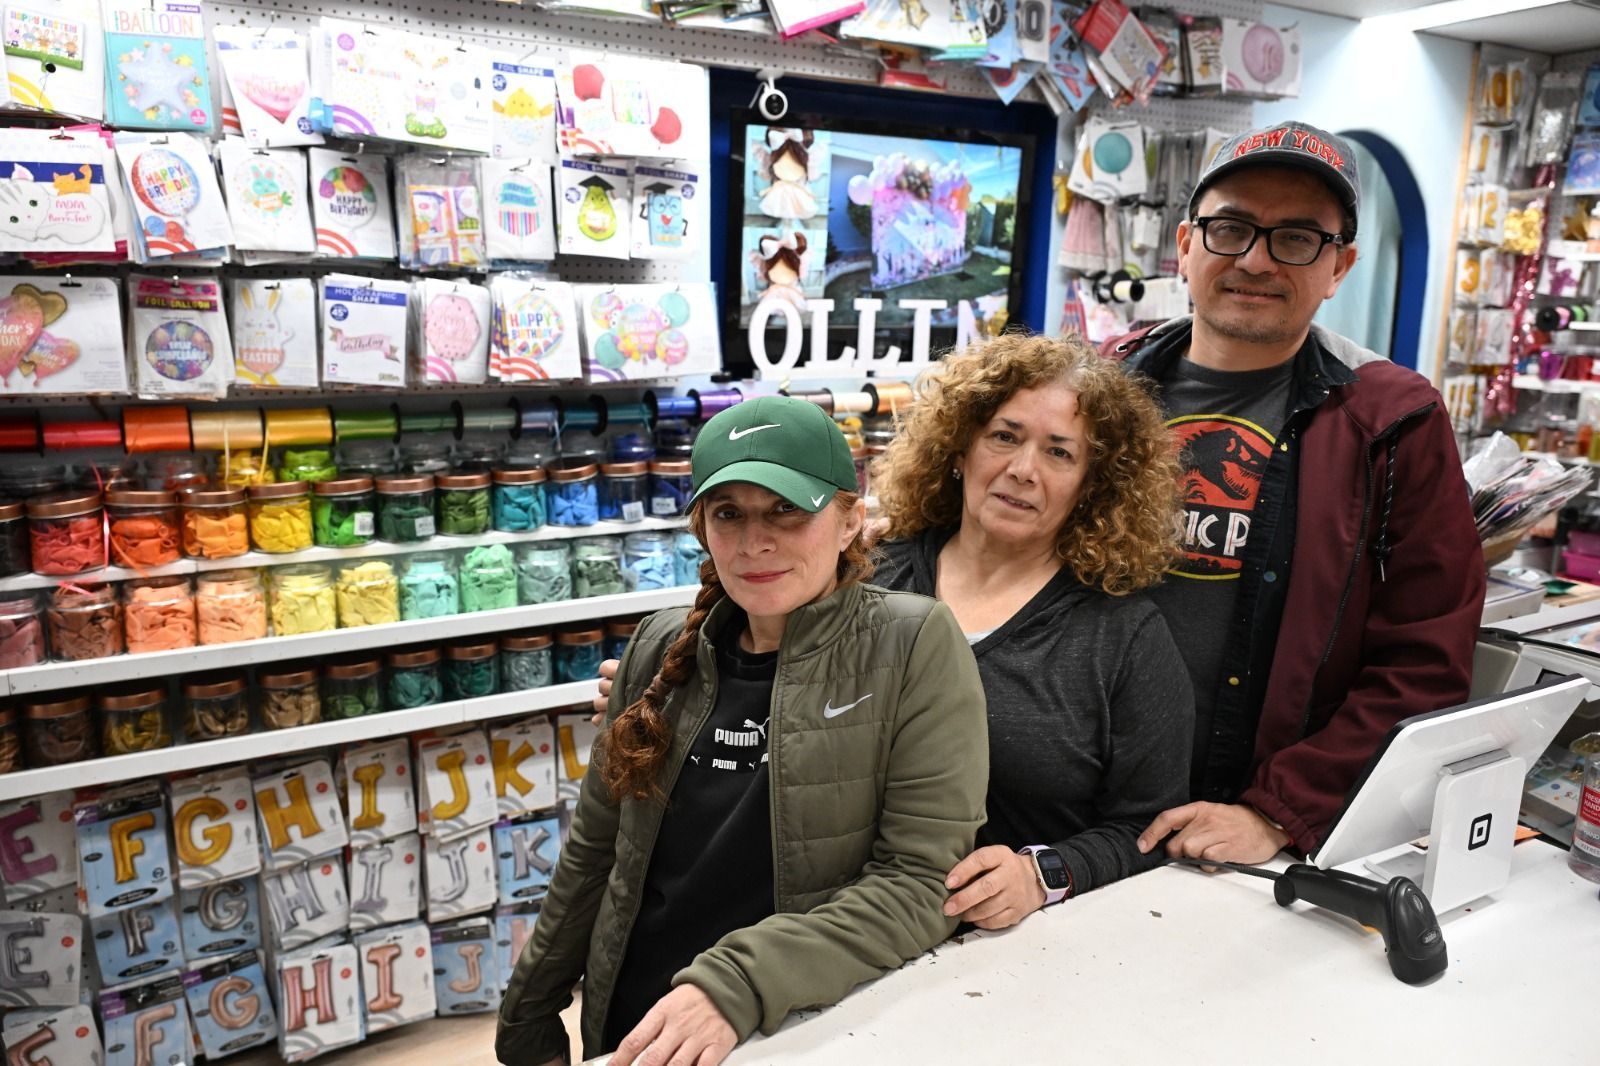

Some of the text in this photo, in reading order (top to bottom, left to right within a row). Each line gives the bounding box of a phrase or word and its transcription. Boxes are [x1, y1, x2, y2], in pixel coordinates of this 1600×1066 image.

[119, 10, 193, 35] BALLOON
[518, 66, 543, 75] SHAPE
[571, 162, 617, 174] FOIL SHAPE
[1234, 127, 1344, 171] NEW YORK
[145, 163, 183, 186] HAPPY
[147, 176, 192, 199] BIRTHDAY
[664, 171, 689, 181] SHAPE
[336, 195, 362, 205] HAPPY
[145, 296, 166, 305] FOIL
[335, 287, 397, 299] HOLOGRAPHIC
[352, 295, 380, 304] SHAPE
[1, 335, 21, 346] DAY
[510, 312, 551, 327] HAPPY
[512, 328, 553, 340] BIRTHDAY
[243, 351, 280, 364] EASTER
[714, 728, 759, 746] PUMA
[431, 749, 470, 820] J
[492, 739, 536, 797] K
[256, 778, 324, 852] H
[352, 762, 385, 830] I
[0, 804, 58, 885] E
[109, 811, 155, 885] F
[174, 797, 232, 867] G
[510, 826, 554, 880] K
[353, 846, 392, 912] I
[429, 839, 469, 904] J
[198, 880, 249, 931] G
[266, 866, 326, 933] H
[0, 921, 50, 990] E
[367, 943, 403, 1013] I
[448, 943, 484, 993] J
[208, 976, 260, 1030] G
[283, 958, 337, 1033] H
